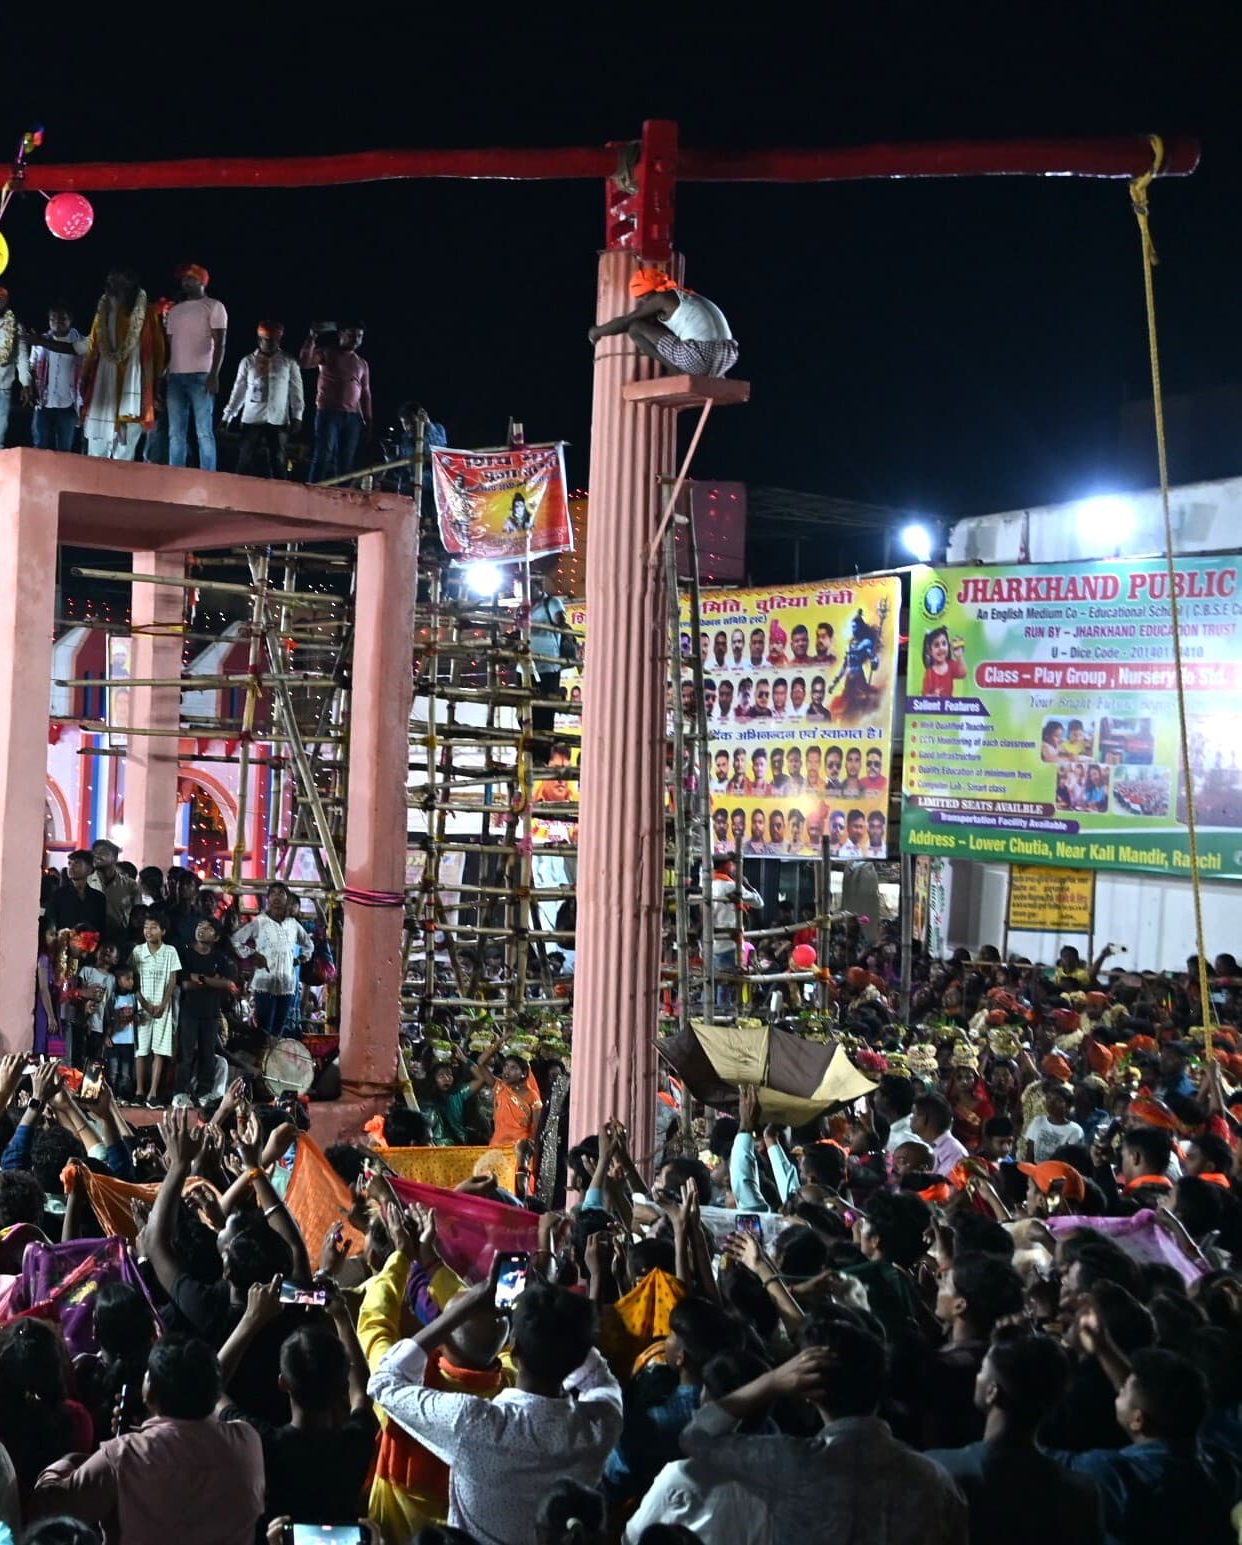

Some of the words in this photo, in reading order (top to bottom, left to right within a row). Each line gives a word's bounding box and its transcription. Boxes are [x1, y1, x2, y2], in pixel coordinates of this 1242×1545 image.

[957, 575, 1119, 603] JHARKHAND
[1128, 570, 1235, 600] PUBLIC
[977, 609, 988, 620] An
[991, 607, 1023, 622] English
[1027, 606, 1062, 619] Medium
[1065, 607, 1077, 618] Co
[1089, 604, 1145, 618] Educational
[1024, 627, 1044, 639] RUN
[1048, 627, 1061, 638] BY
[1073, 625, 1136, 638] JHARKHAND
[1203, 623, 1236, 636] TRUST
[1051, 647, 1057, 658] U
[1070, 646, 1092, 658] Dice
[1095, 646, 1119, 658] Code
[984, 666, 1019, 684] Class
[1034, 666, 1063, 686] Play
[1066, 668, 1106, 687] Group
[1119, 668, 1176, 688] Nursery
[945, 701, 980, 712] Features
[736, 729, 795, 741] अभिनन्दन
[820, 728, 862, 740] स्वागत
[982, 738, 998, 747] each
[942, 767, 975, 776] Education
[918, 797, 959, 809] LIMITED
[961, 800, 992, 812] SEATS
[995, 802, 1044, 815] AVAILBLE
[940, 813, 997, 825] Transportation
[998, 816, 1028, 829] Facility
[1029, 819, 1068, 831] Available
[909, 830, 955, 848] Address
[969, 834, 1007, 852] Lower
[1010, 837, 1053, 860] Chutia,
[1056, 841, 1086, 860] Near
[1089, 843, 1115, 862] Kali
[1119, 846, 1169, 869] Mandir,
